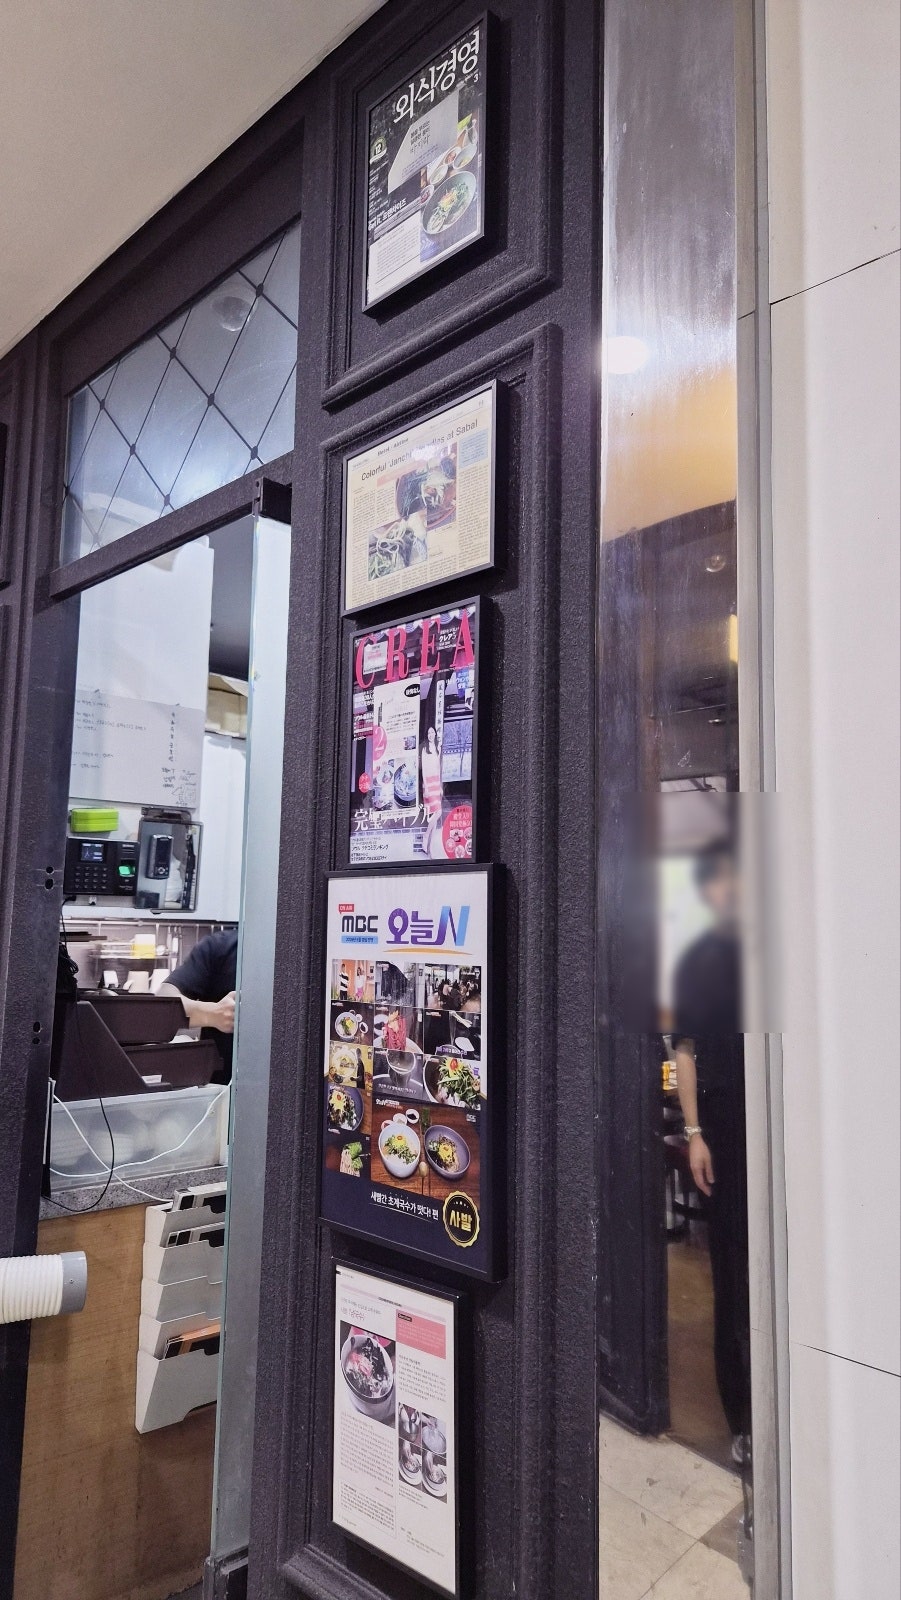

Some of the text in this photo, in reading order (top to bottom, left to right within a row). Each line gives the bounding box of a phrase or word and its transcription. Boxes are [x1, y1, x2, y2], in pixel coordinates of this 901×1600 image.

[393, 30, 480, 124] 외식경영
[361, 463, 387, 481] Colorful
[446, 430, 454, 441] at
[456, 419, 478, 437] Sabal
[355, 608, 475, 690] CREA
[342, 915, 379, 933] MBC
[386, 905, 470, 946] 오늘N
[387, 1195, 416, 1214] 초계국수가
[432, 1208, 439, 1221] 편
[449, 1209, 473, 1232] 사발
